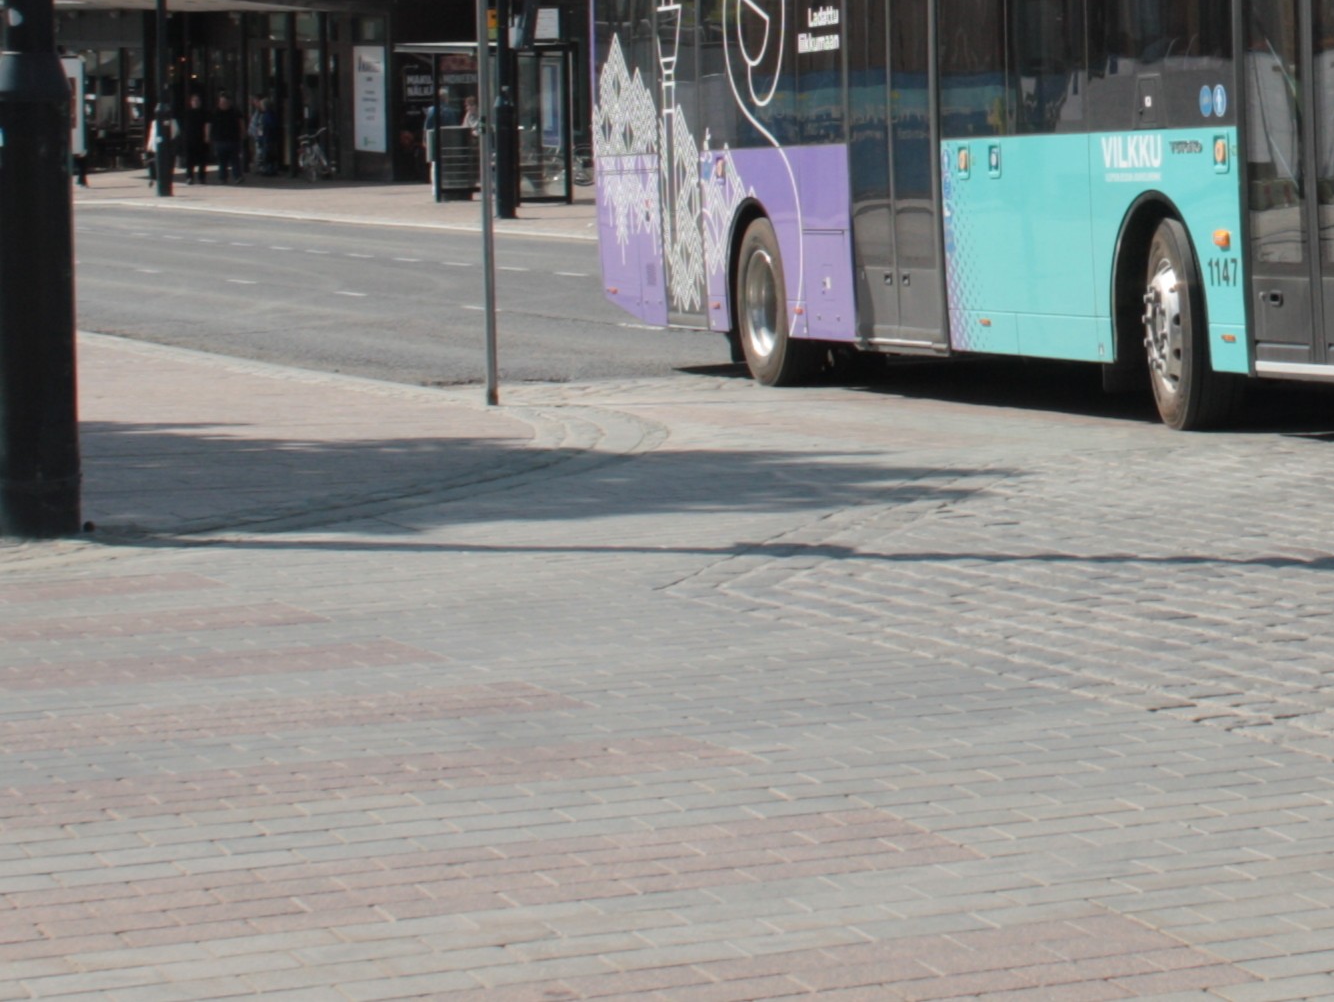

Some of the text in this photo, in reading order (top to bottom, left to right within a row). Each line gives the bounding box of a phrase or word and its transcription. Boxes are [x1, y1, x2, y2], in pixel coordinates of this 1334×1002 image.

[808, 6, 839, 27] Ladattu
[1102, 134, 1162, 168] VILKKU
[1208, 258, 1237, 286] 1147
